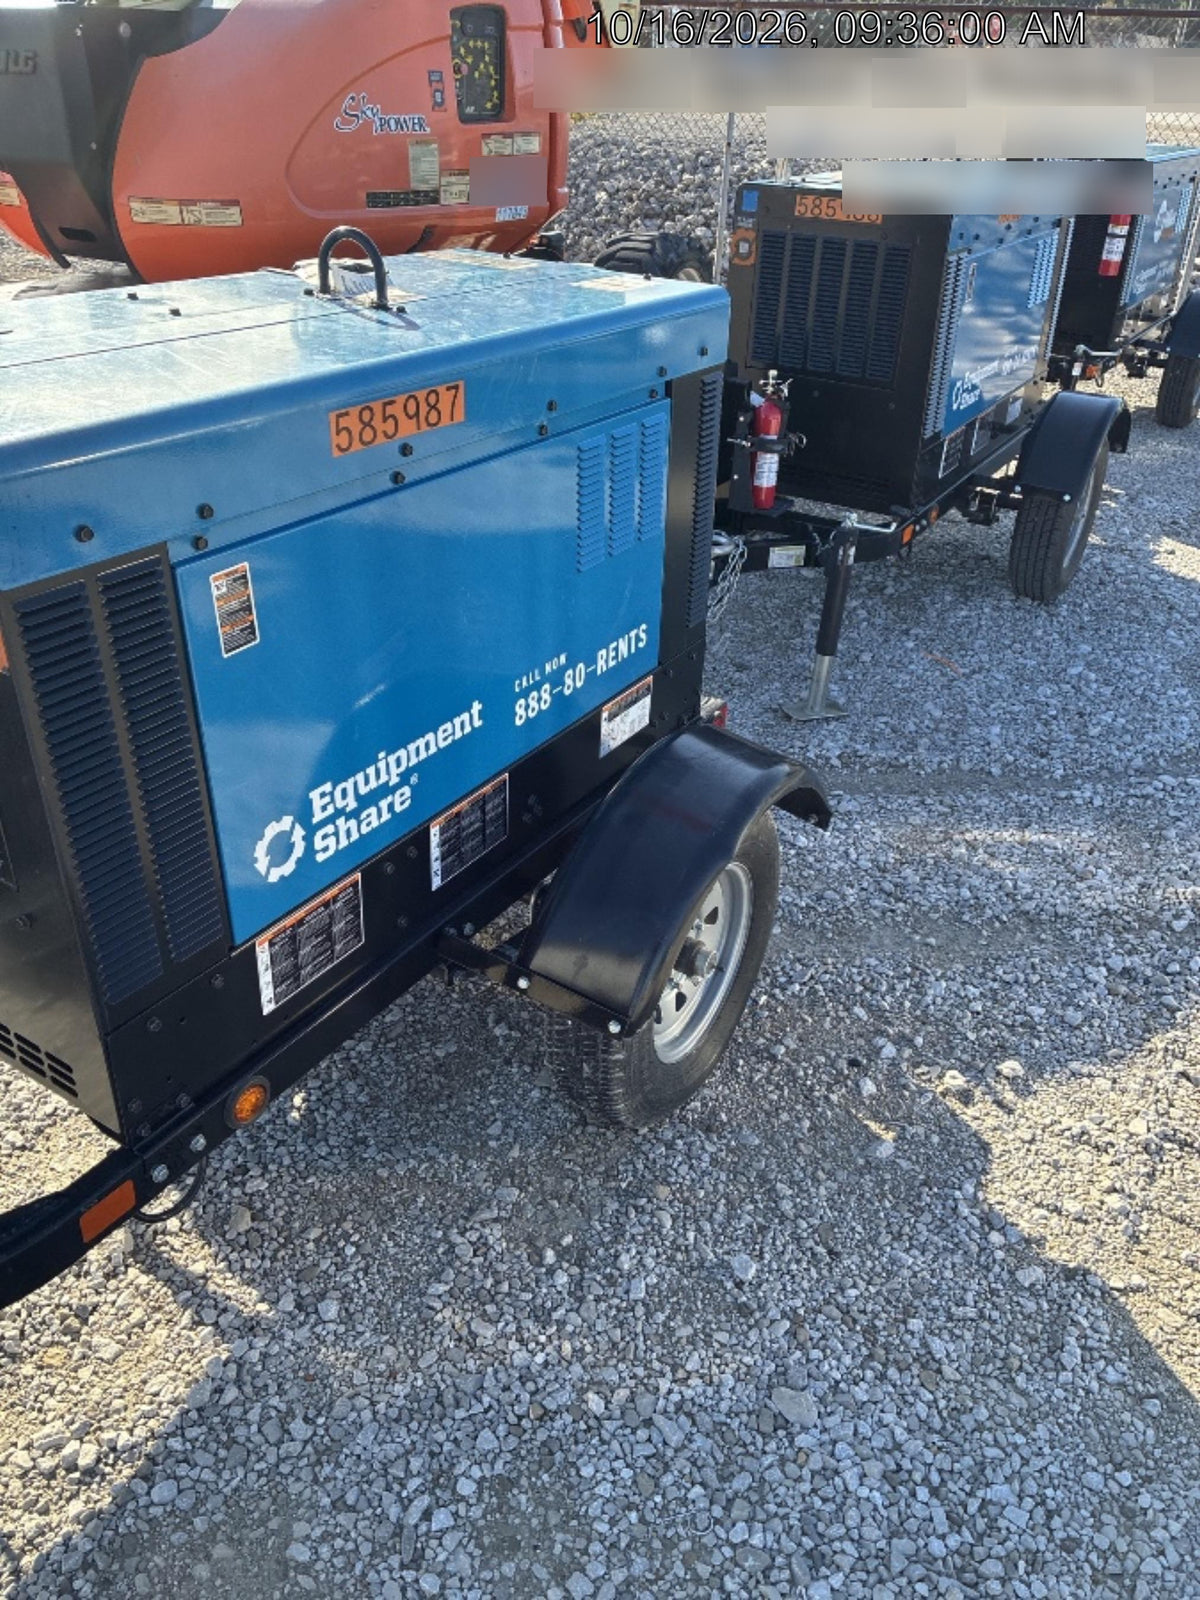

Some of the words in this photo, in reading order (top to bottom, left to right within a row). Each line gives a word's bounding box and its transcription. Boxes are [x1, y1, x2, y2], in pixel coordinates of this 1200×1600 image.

[796, 196, 881, 223] 585
[335, 383, 460, 453] 585987
[515, 668, 542, 693] CALL
[545, 652, 568, 675] NOW
[515, 623, 648, 726] 888-80-RENTS
[309, 699, 483, 825] Equipment
